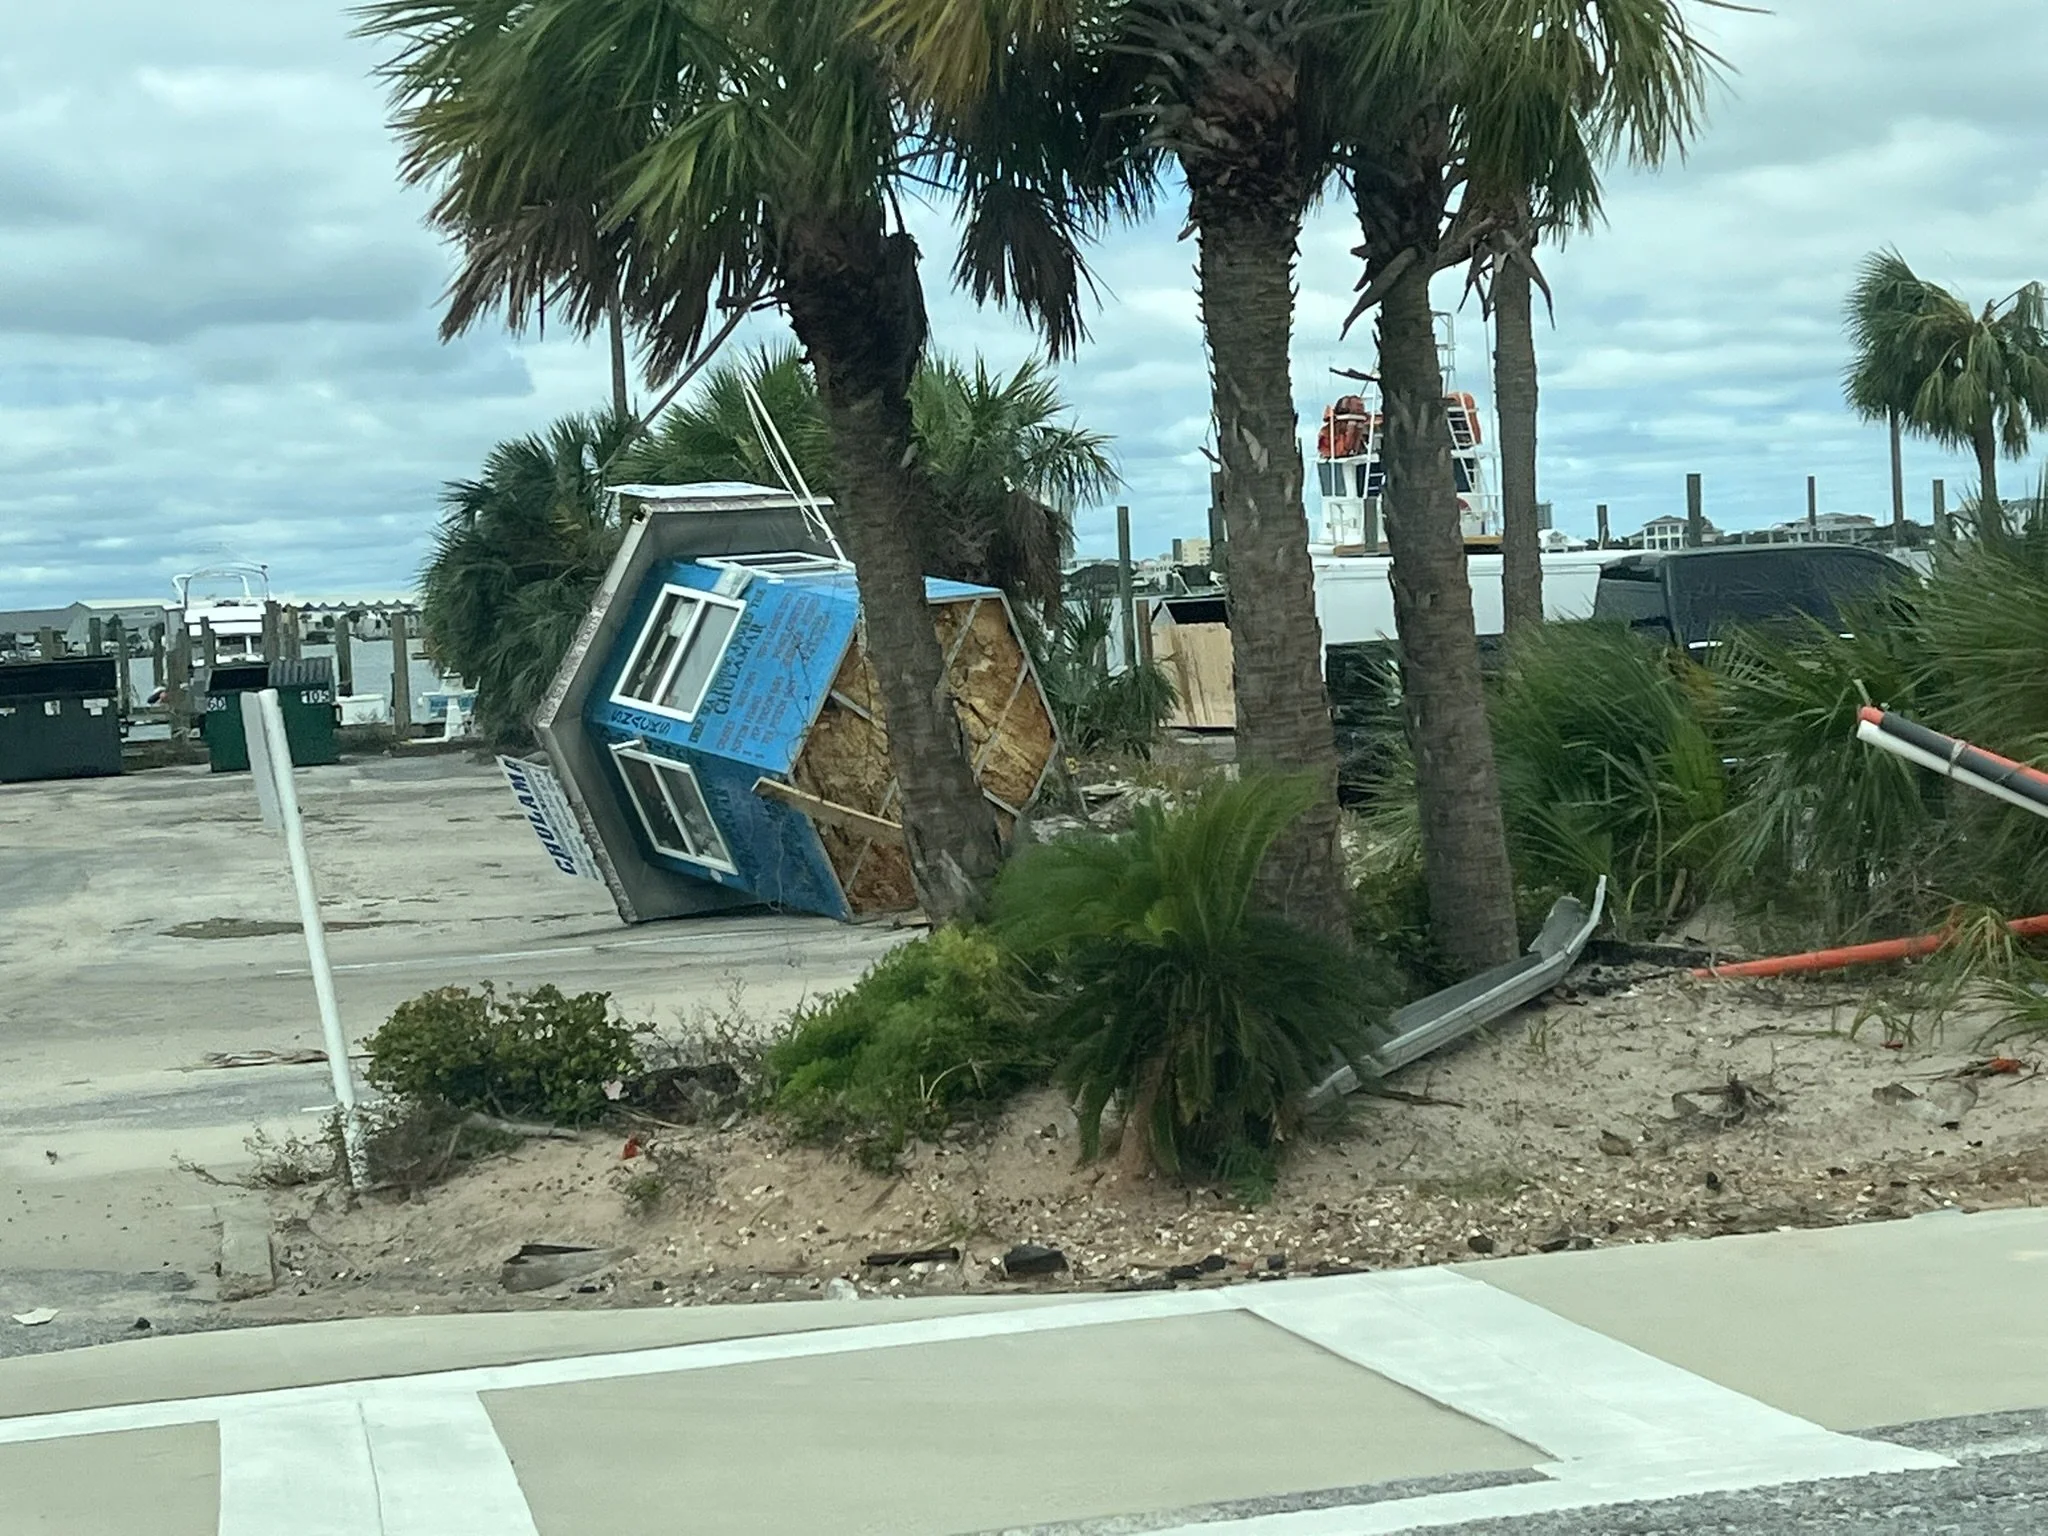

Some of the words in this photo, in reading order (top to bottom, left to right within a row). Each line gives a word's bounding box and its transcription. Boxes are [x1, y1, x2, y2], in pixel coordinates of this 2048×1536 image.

[714, 622, 765, 715] CHULAMAR
[301, 690, 329, 703] 105
[611, 711, 671, 736] SNACKS
